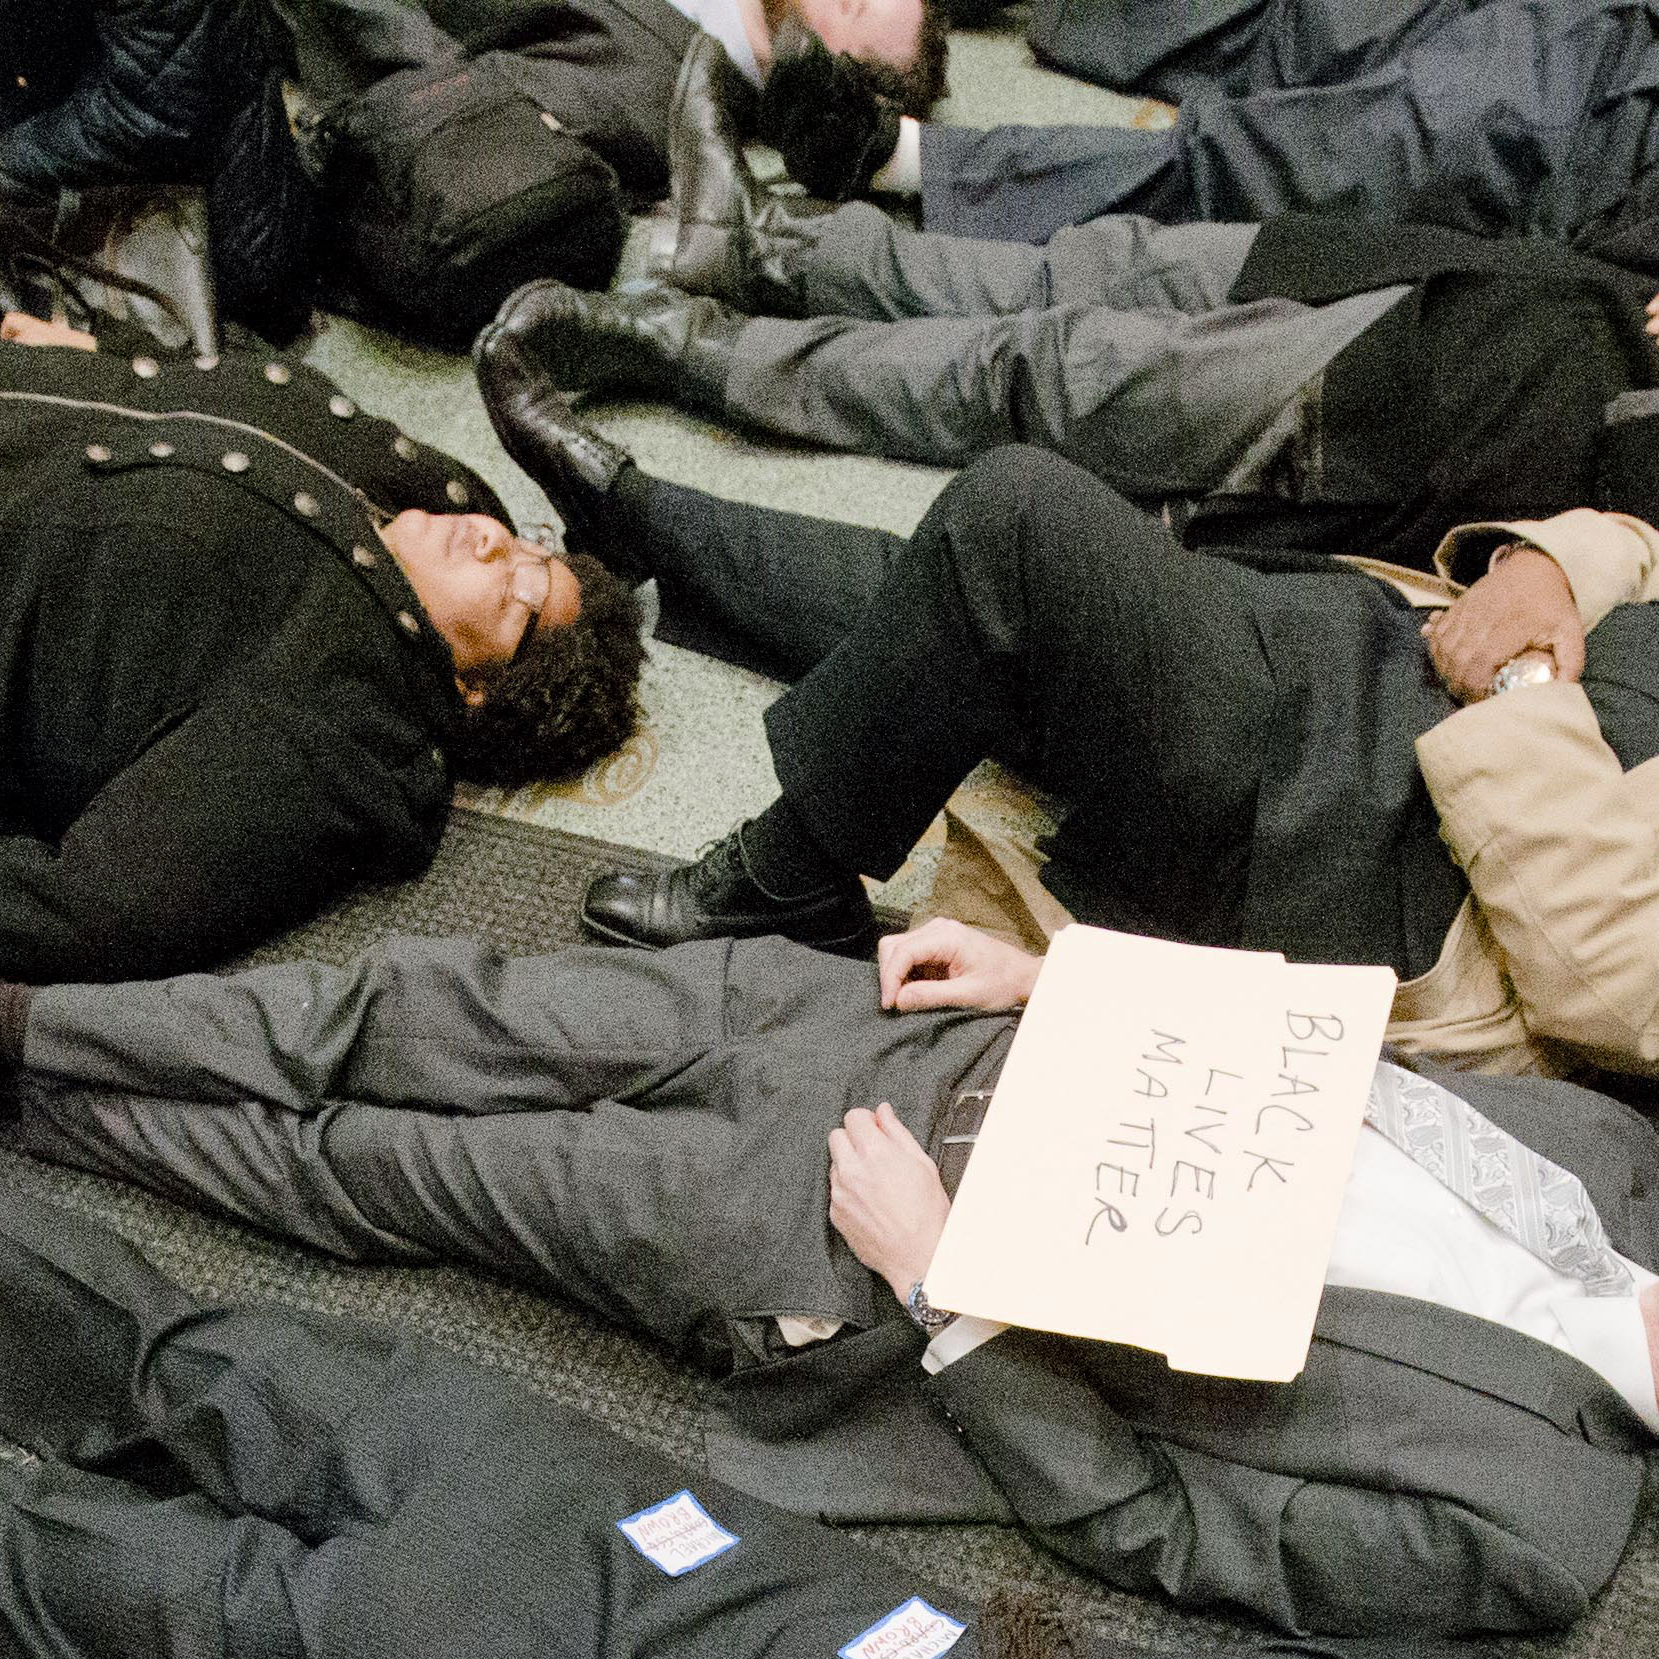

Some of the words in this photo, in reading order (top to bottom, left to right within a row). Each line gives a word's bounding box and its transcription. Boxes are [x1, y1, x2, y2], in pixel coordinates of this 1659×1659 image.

[1085, 1028, 1187, 1246] MATTER
[1154, 1068, 1244, 1237] LIVES
[1243, 1009, 1344, 1192] BLACK
[636, 1506, 691, 1541] BROWN
[861, 1618, 922, 1659] BROWN
